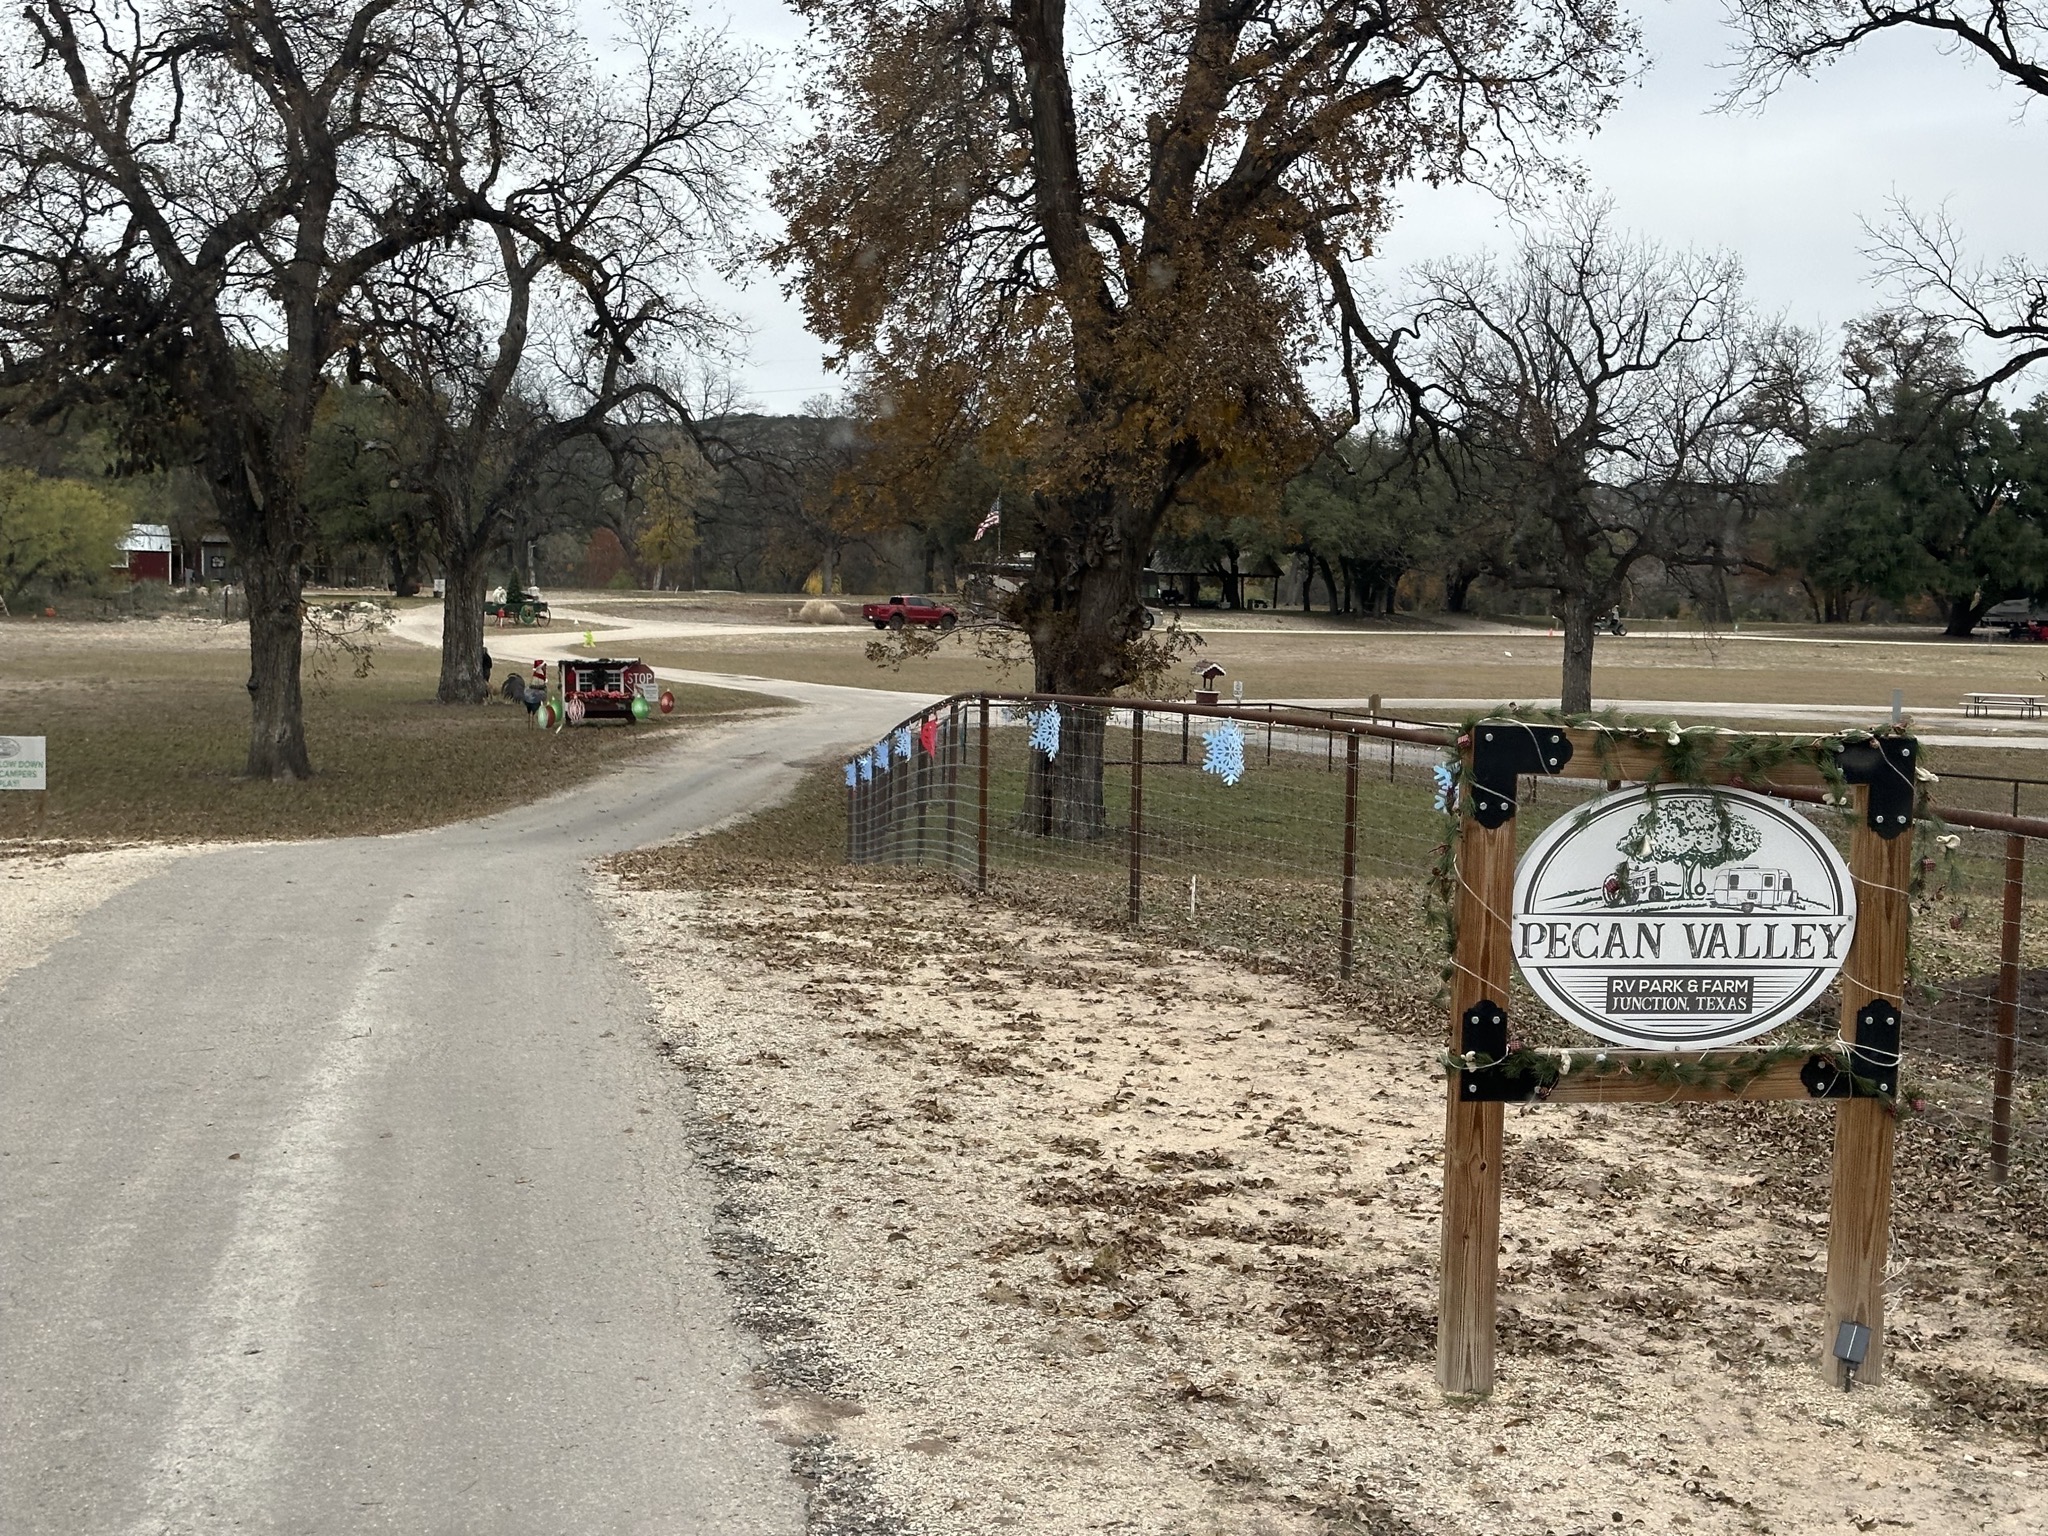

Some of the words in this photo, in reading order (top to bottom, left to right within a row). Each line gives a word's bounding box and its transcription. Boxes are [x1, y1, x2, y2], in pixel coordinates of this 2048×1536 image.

[627, 672, 653, 684] STOP
[18, 760, 44, 769] DOWN
[0, 770, 37, 778] CAMPERS
[1518, 922, 1665, 959] PECAN
[1682, 922, 1847, 960] VALLEY
[1612, 979, 1636, 993] RV
[1638, 979, 1684, 993] PARK
[1687, 979, 1699, 993] &
[1702, 979, 1749, 993] FARM
[1611, 996, 1690, 1012] JUNCTION,
[1695, 996, 1748, 1012] TEXAS
